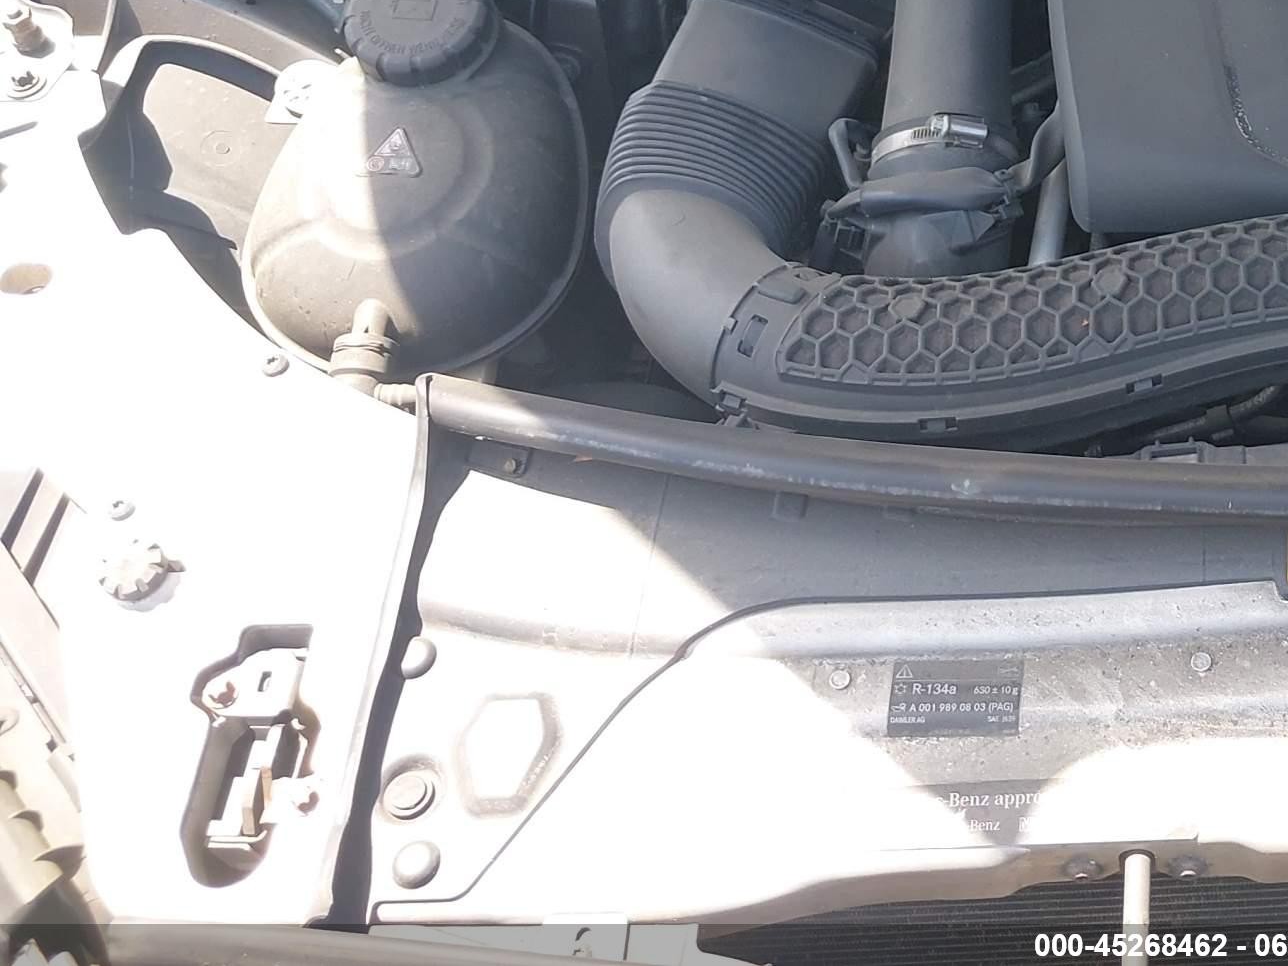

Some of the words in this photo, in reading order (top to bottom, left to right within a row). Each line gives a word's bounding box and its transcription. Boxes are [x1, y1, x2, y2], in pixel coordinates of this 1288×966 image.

[912, 683, 958, 695] R-134a
[1001, 686, 1012, 694] 10
[909, 703, 917, 712] A
[918, 703, 936, 712] 001
[939, 703, 957, 712] 989
[959, 703, 972, 711] 08
[974, 702, 986, 711] 03
[988, 701, 1014, 713] (PAG)
